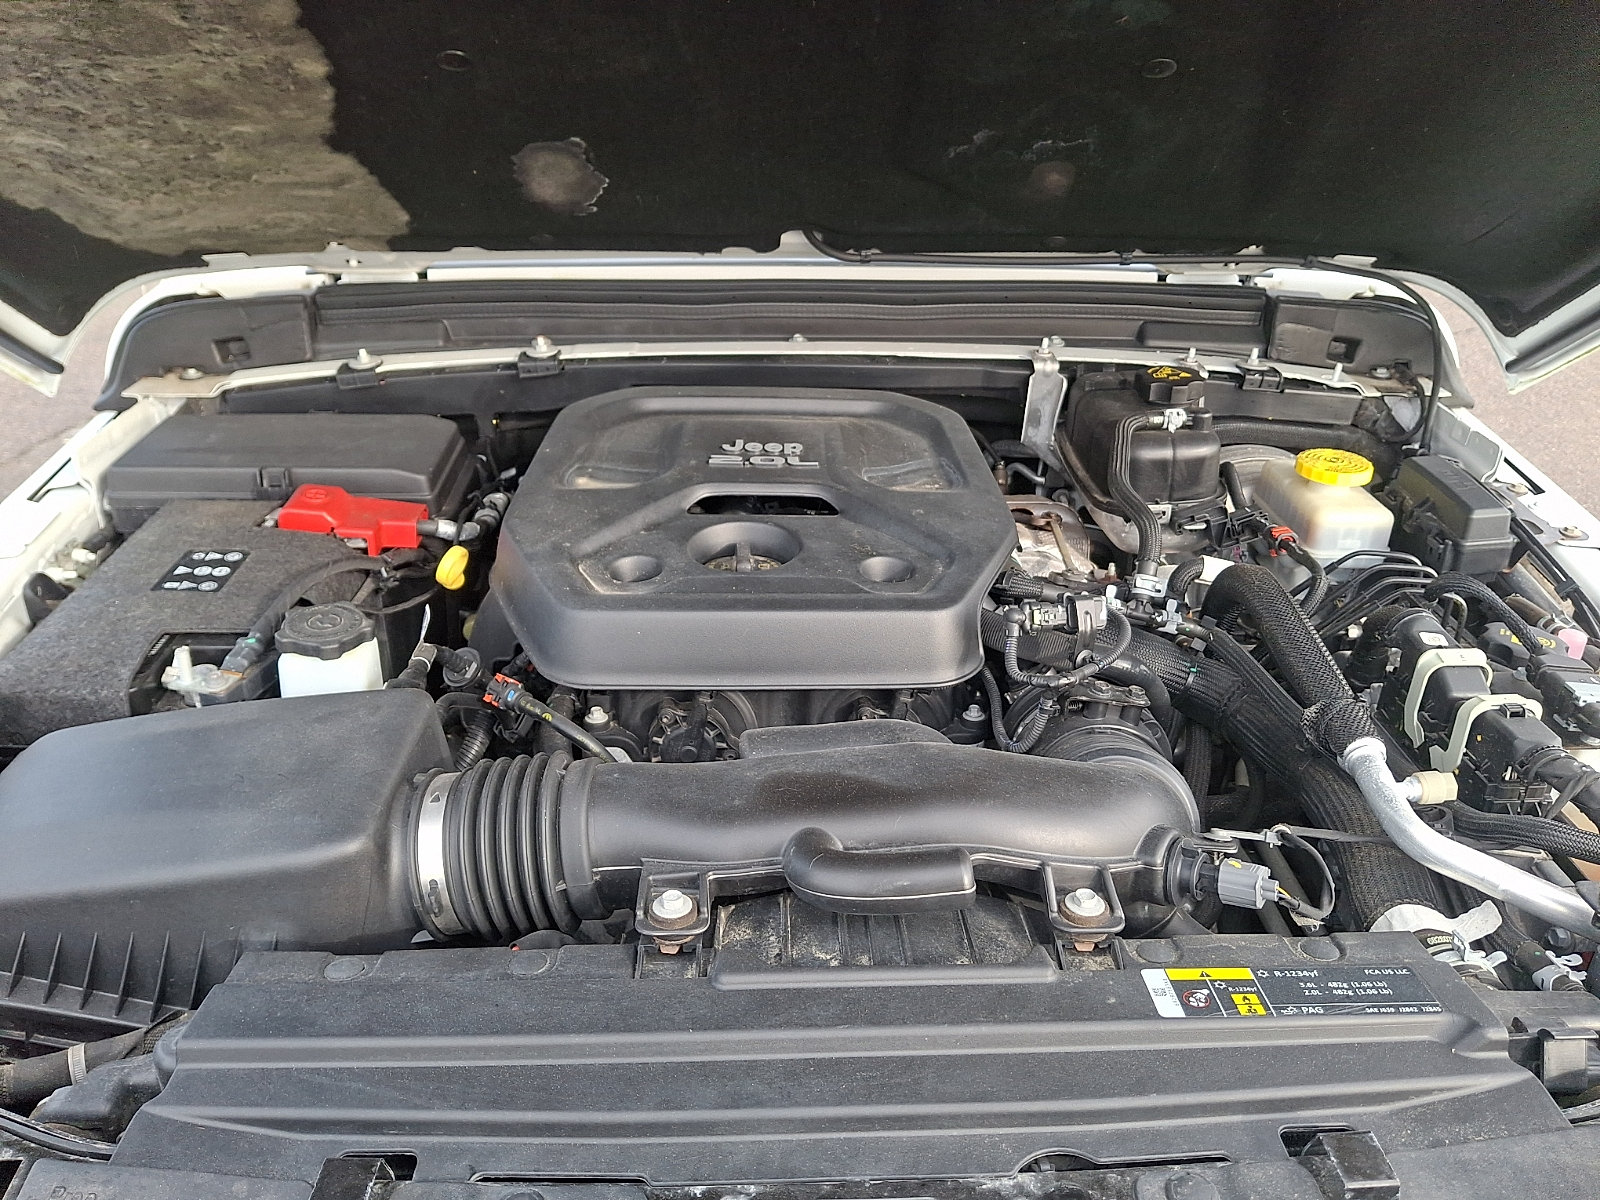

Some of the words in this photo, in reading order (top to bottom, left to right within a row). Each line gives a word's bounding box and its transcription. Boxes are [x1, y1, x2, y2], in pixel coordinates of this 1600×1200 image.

[721, 439, 804, 456] Jeep
[708, 454, 820, 468] 2.0L
[1273, 969, 1319, 978] R-1234yf
[1363, 968, 1381, 976] FCA
[1301, 1006, 1324, 1014] PAG
